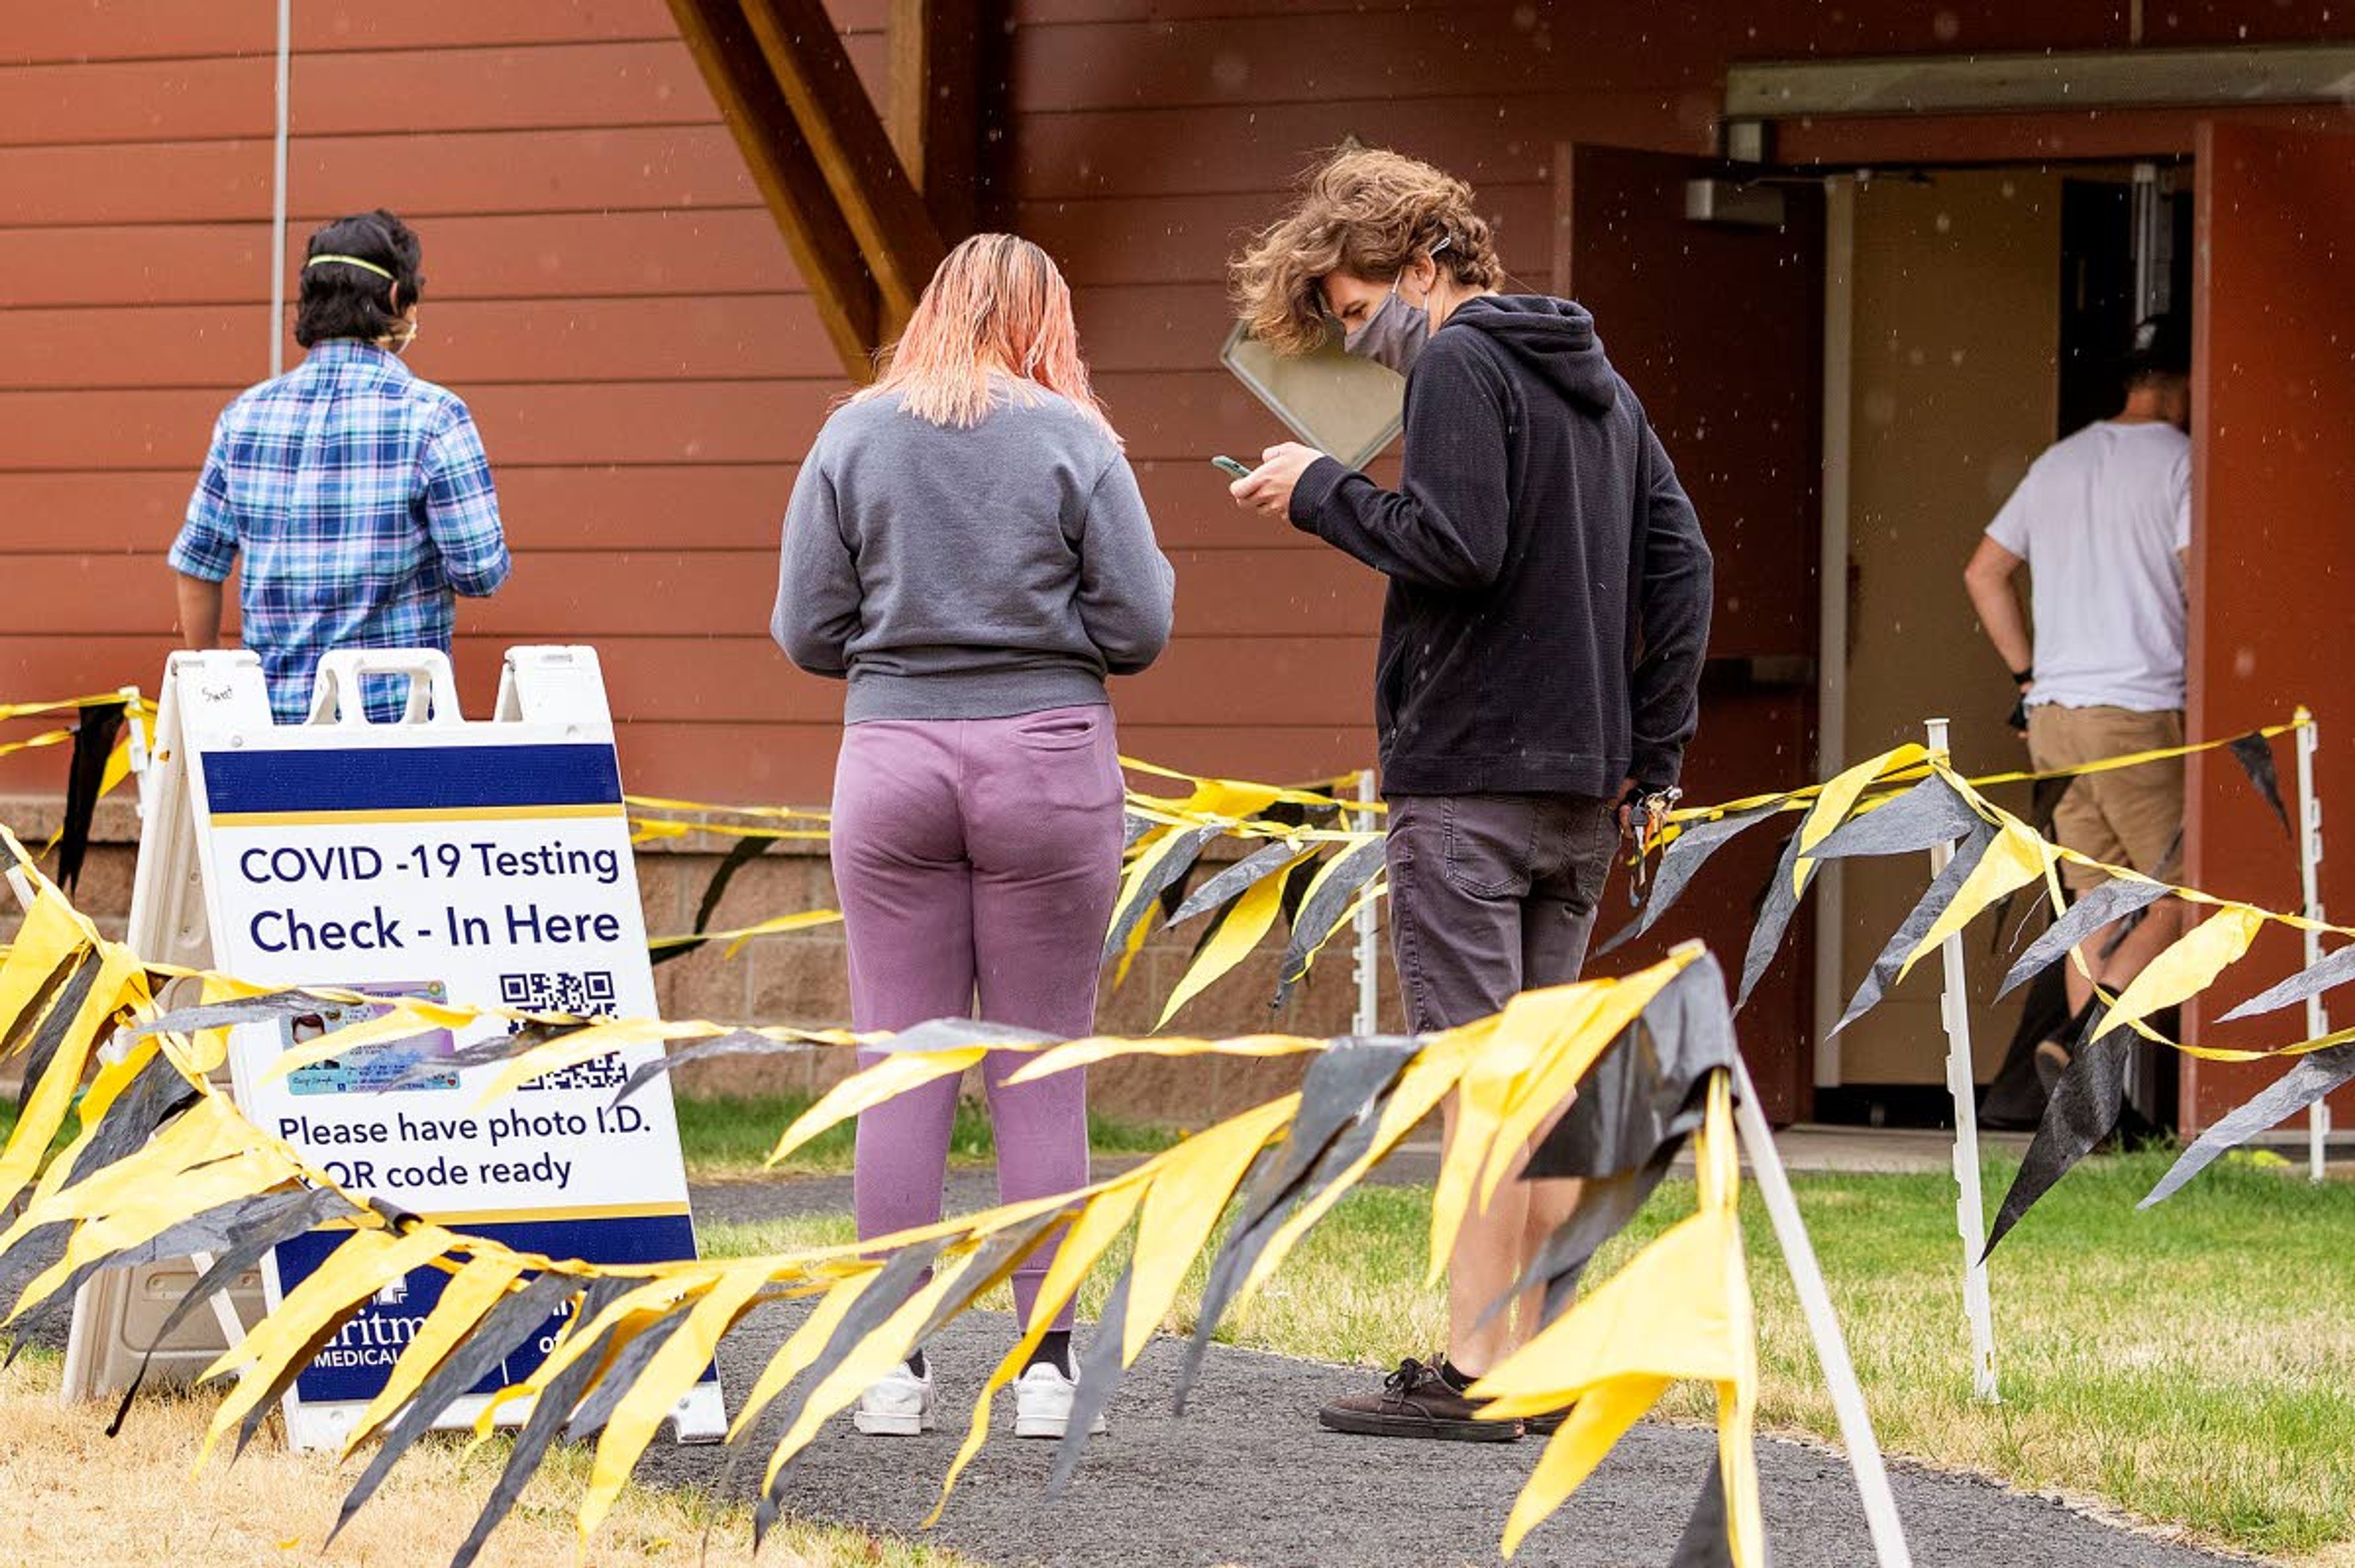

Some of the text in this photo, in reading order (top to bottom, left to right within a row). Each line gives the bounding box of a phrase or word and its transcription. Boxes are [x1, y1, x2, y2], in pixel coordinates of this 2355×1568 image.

[240, 847, 382, 884] COVID
[471, 841, 619, 884] Testing
[250, 906, 404, 952] Check
[447, 907, 489, 946] In
[505, 904, 619, 945] Here
[280, 1105, 651, 1147] Please have photo I.D.
[324, 1161, 377, 1188] QR
[386, 1156, 468, 1188] code
[480, 1152, 572, 1190] ready
[313, 1347, 399, 1368] MEDICAL
